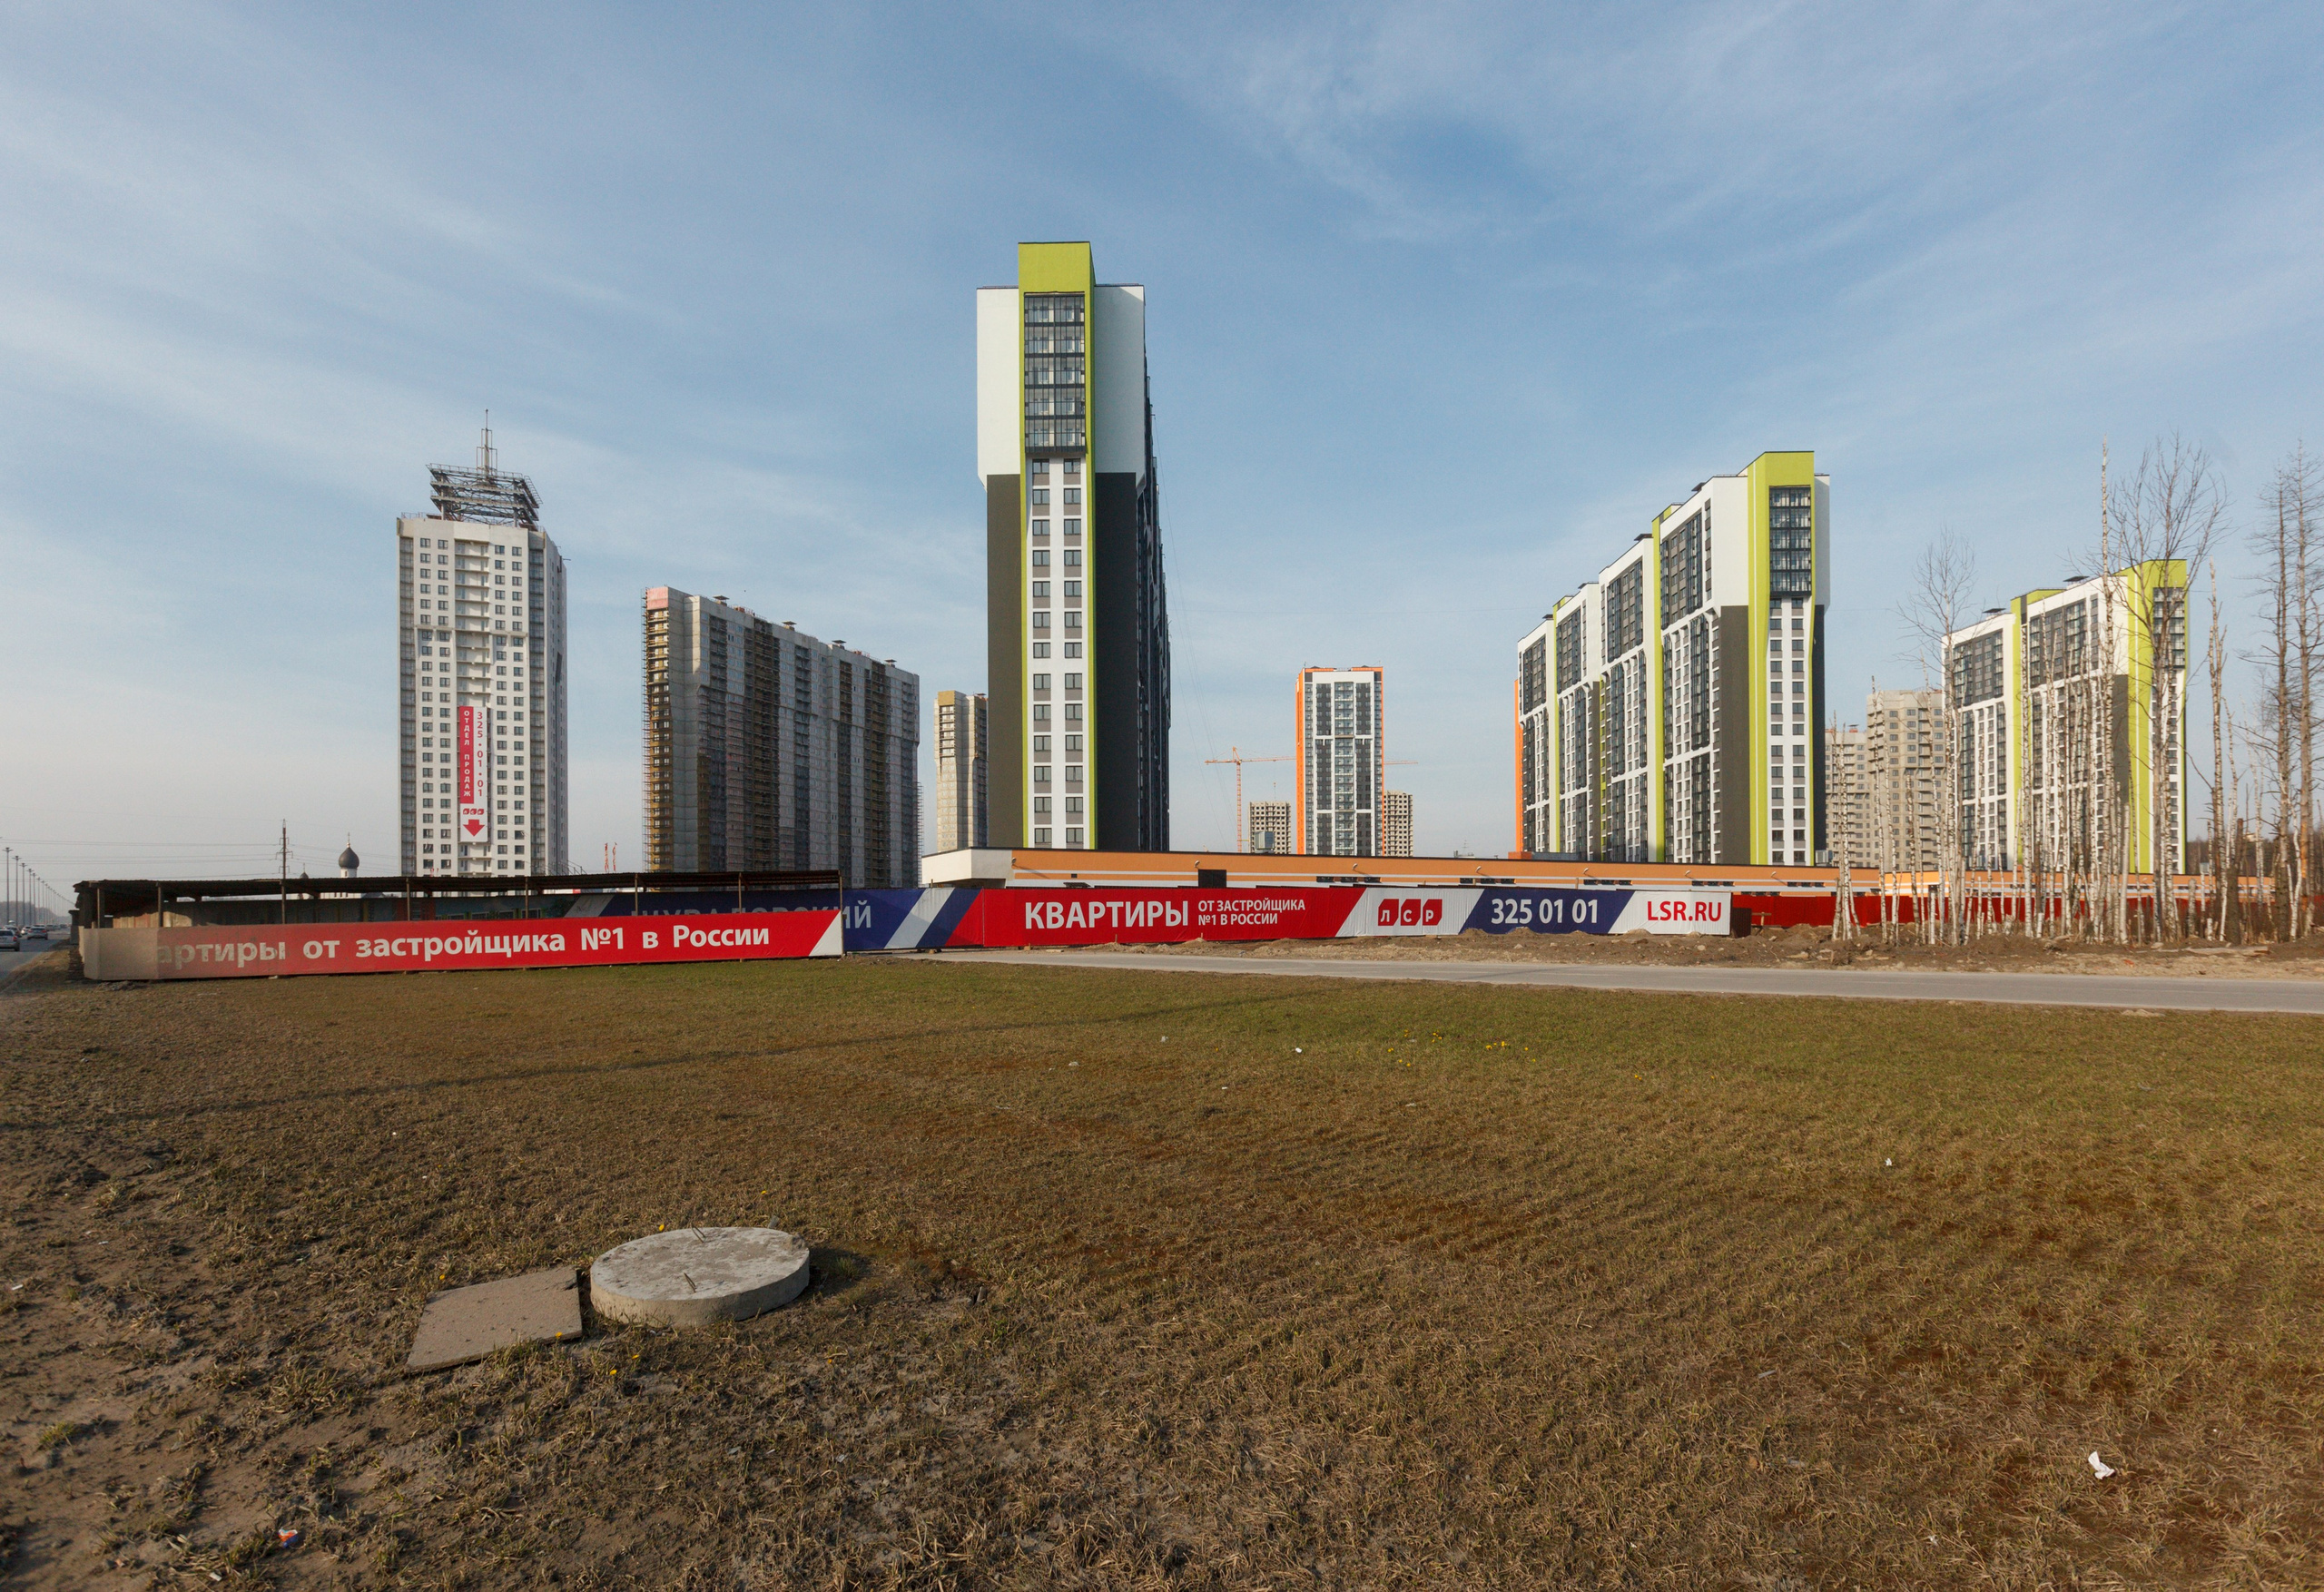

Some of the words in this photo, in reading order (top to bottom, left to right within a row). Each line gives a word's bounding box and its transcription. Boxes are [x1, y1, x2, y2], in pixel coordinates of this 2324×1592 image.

[463, 754, 471, 797] ПРОДАЖ
[1025, 900, 1188, 929] КВАРТИРЫ
[1197, 900, 1216, 912] ОТ
[1216, 898, 1305, 913] ЗАСТРОЙЩИКА
[1379, 902, 1435, 924] ЛСР
[1491, 898, 1532, 924] 325
[1539, 898, 1563, 924] 01
[1572, 898, 1598, 924] 01
[1647, 900, 1722, 922] LSR.RU
[1197, 914, 1216, 926] №1
[1220, 914, 1228, 926] В
[1230, 913, 1278, 925] РОССИИ
[302, 939, 340, 959] от
[355, 929, 566, 962] застройщика
[580, 927, 625, 951] №1
[642, 930, 659, 949] в
[673, 924, 770, 948] России
